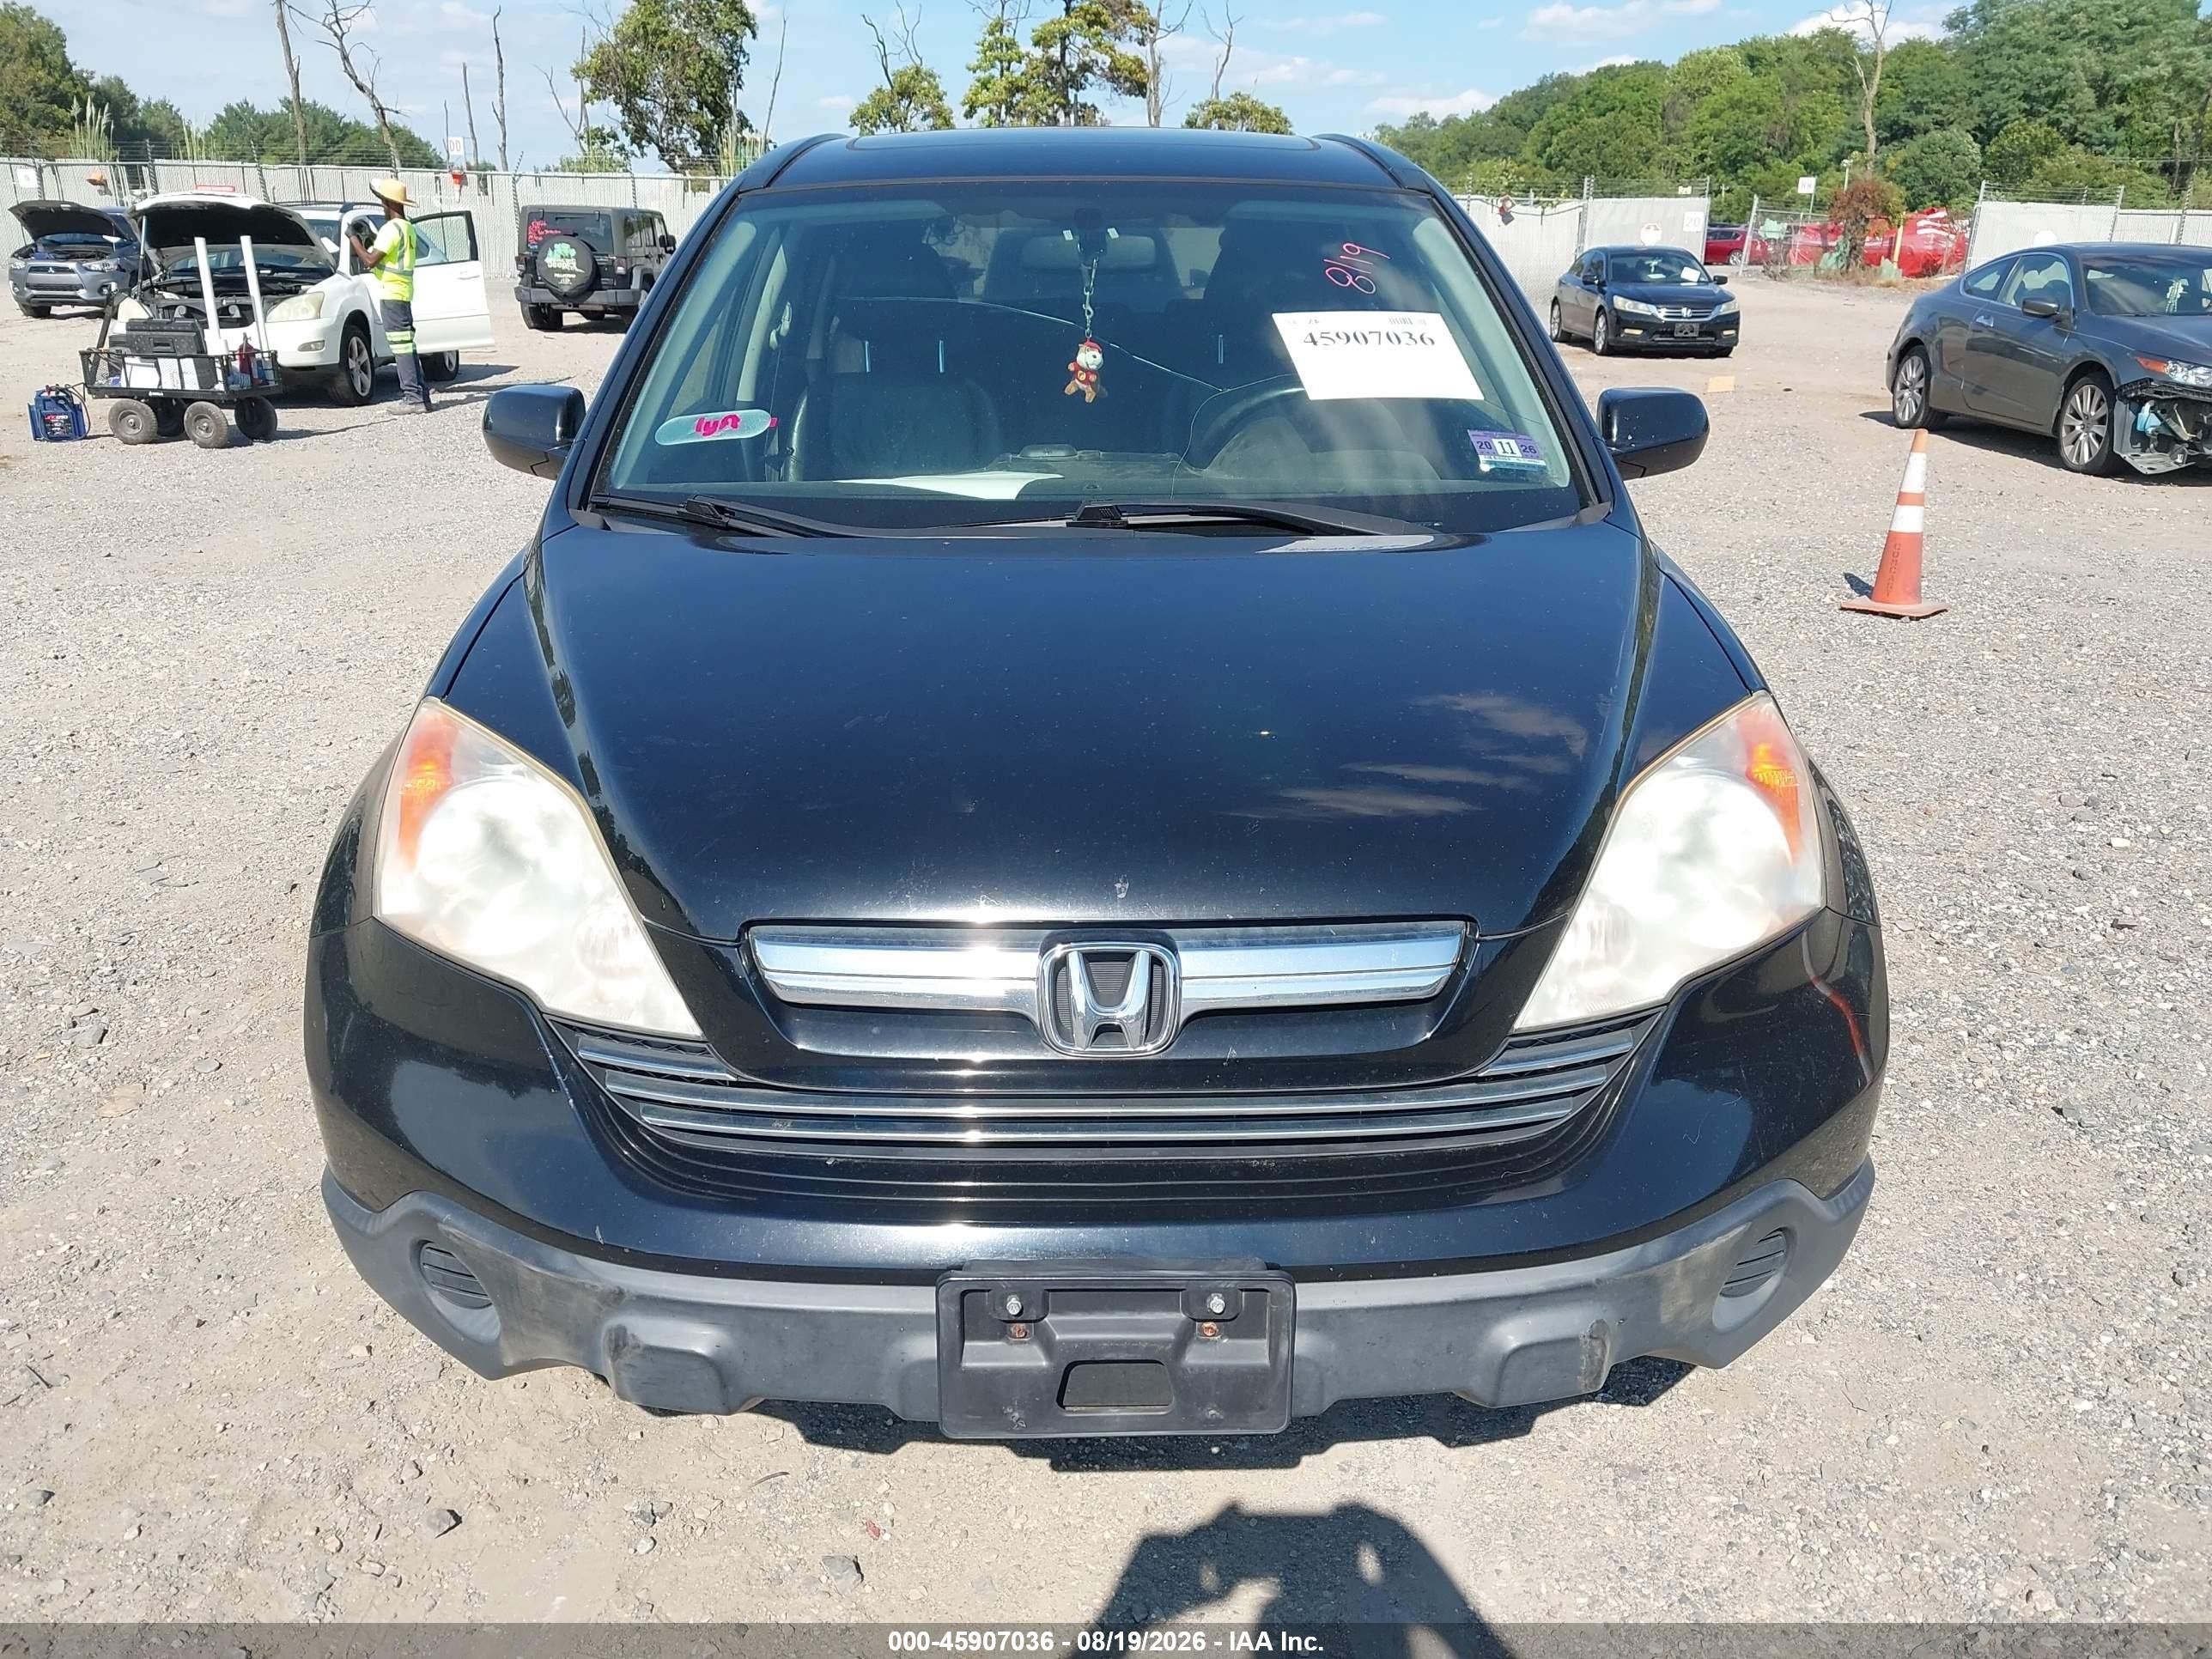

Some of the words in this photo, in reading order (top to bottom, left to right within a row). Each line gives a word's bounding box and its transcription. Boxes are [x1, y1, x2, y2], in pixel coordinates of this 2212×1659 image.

[1685, 216, 1701, 228] 20
[1323, 243, 1390, 294] 8/19
[1304, 331, 1435, 346] 45907036
[695, 414, 741, 437] lyft
[1477, 441, 1492, 450] 20
[1498, 441, 1517, 455] 11
[1520, 444, 1537, 454] 26
